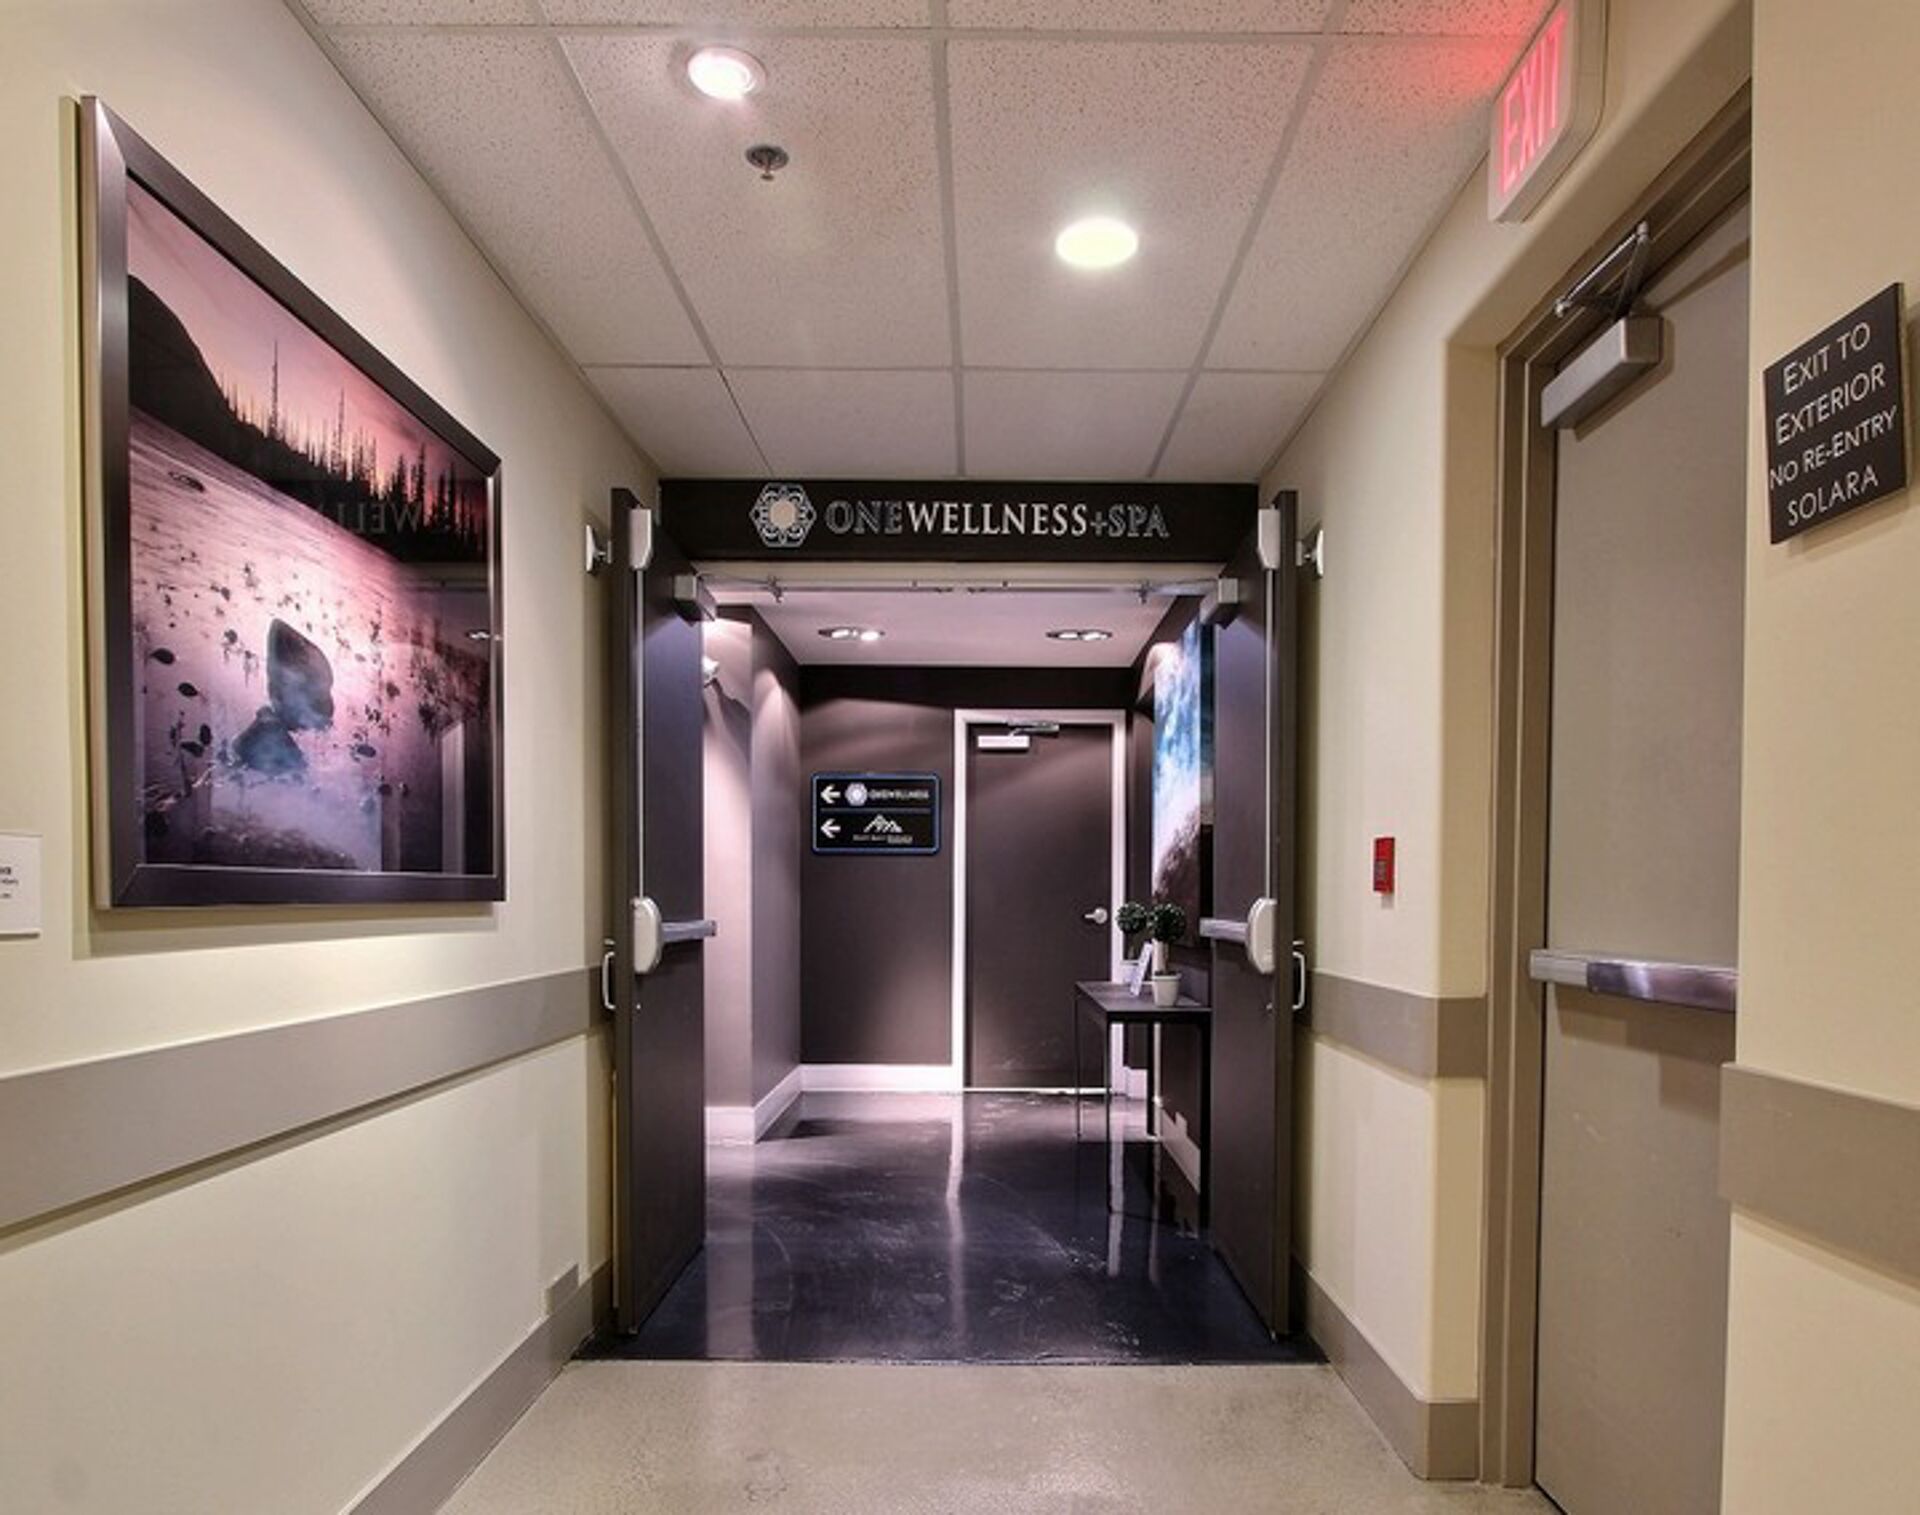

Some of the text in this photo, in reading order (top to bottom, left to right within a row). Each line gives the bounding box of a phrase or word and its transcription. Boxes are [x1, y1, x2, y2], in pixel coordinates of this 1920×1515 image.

[1503, 9, 1568, 193] EXIT
[1782, 322, 1871, 395] EXIT TO
[1775, 362, 1886, 446] EXTERIOR
[1770, 405, 1897, 490] NO RE-ENTRY
[1788, 465, 1879, 526] SOLARA
